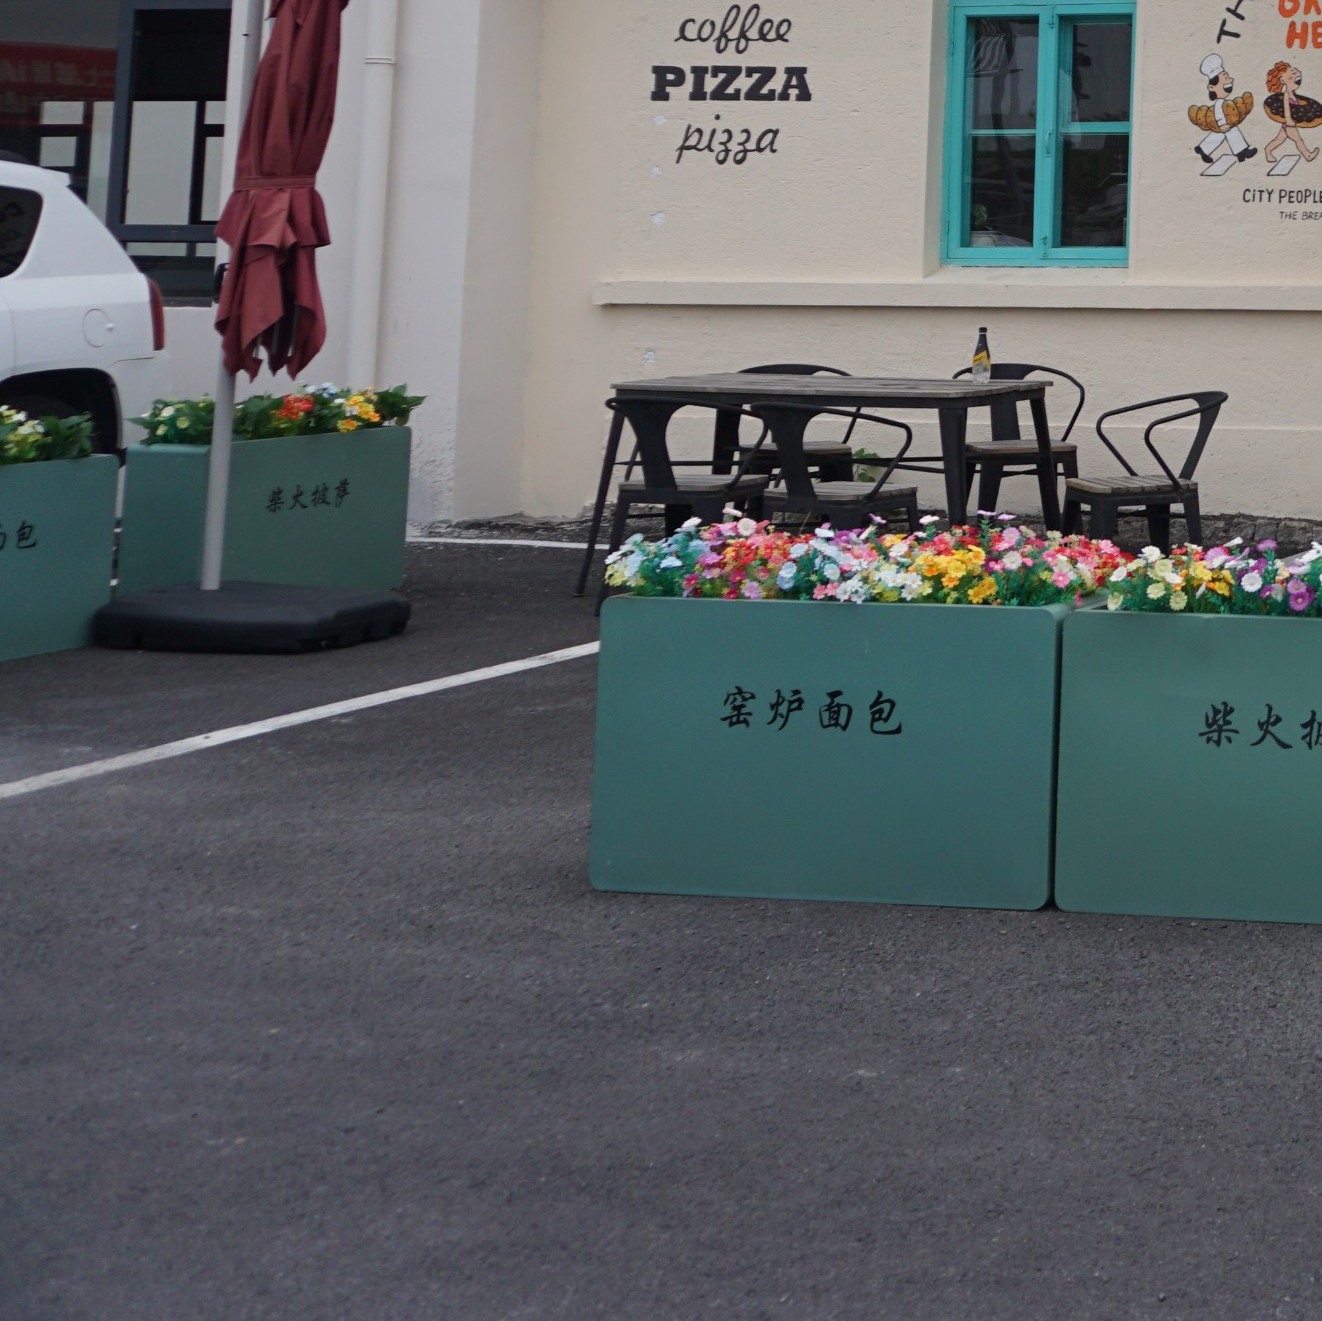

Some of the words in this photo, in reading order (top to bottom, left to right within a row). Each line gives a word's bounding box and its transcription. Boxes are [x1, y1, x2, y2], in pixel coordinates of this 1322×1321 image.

[674, 3, 792, 54] coffee
[650, 65, 812, 102] PIZZA
[675, 114, 779, 165] pizza
[1279, 211, 1298, 220] THE
[720, 686, 903, 736] 窑炉面包
